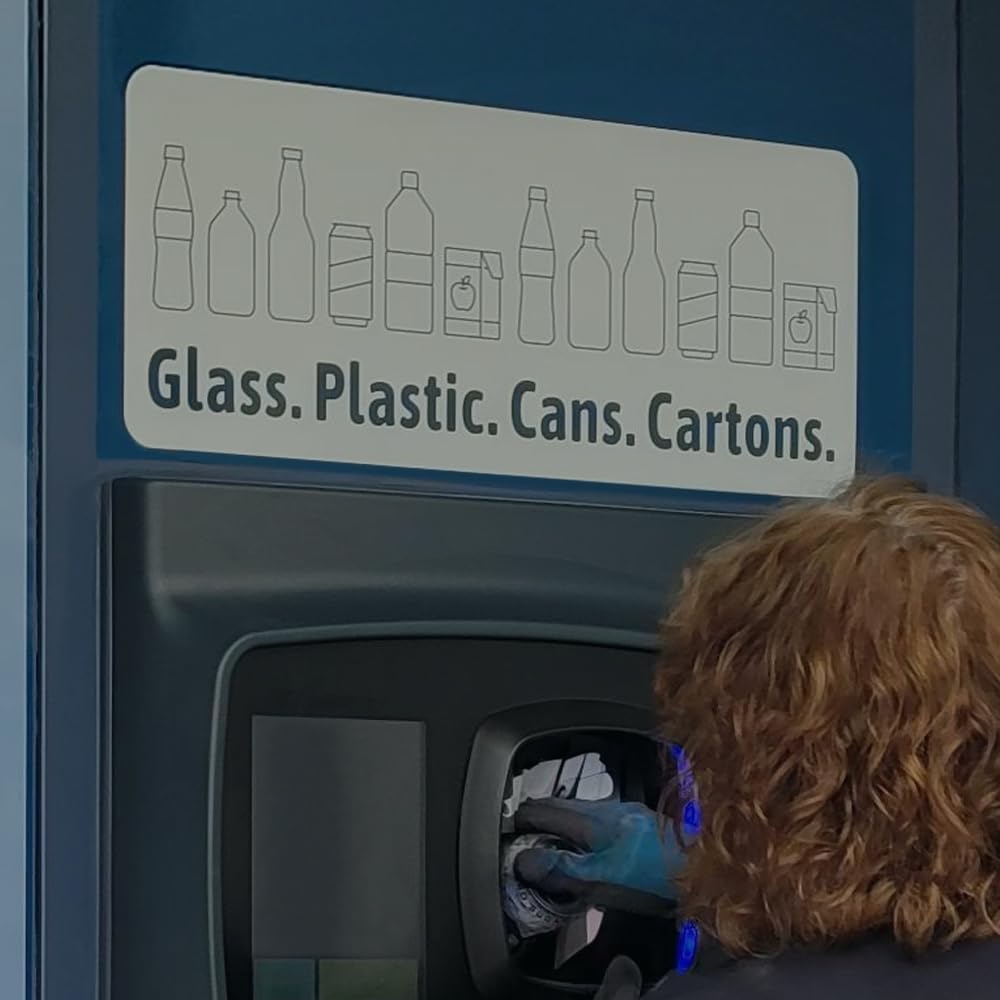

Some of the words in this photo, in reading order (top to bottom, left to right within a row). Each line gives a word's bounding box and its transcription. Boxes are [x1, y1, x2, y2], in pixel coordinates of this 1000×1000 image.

[148, 346, 301, 419] Glass.
[316, 360, 498, 436] Plastic.
[511, 380, 635, 446] Cans.
[649, 392, 835, 462] Cartons.
